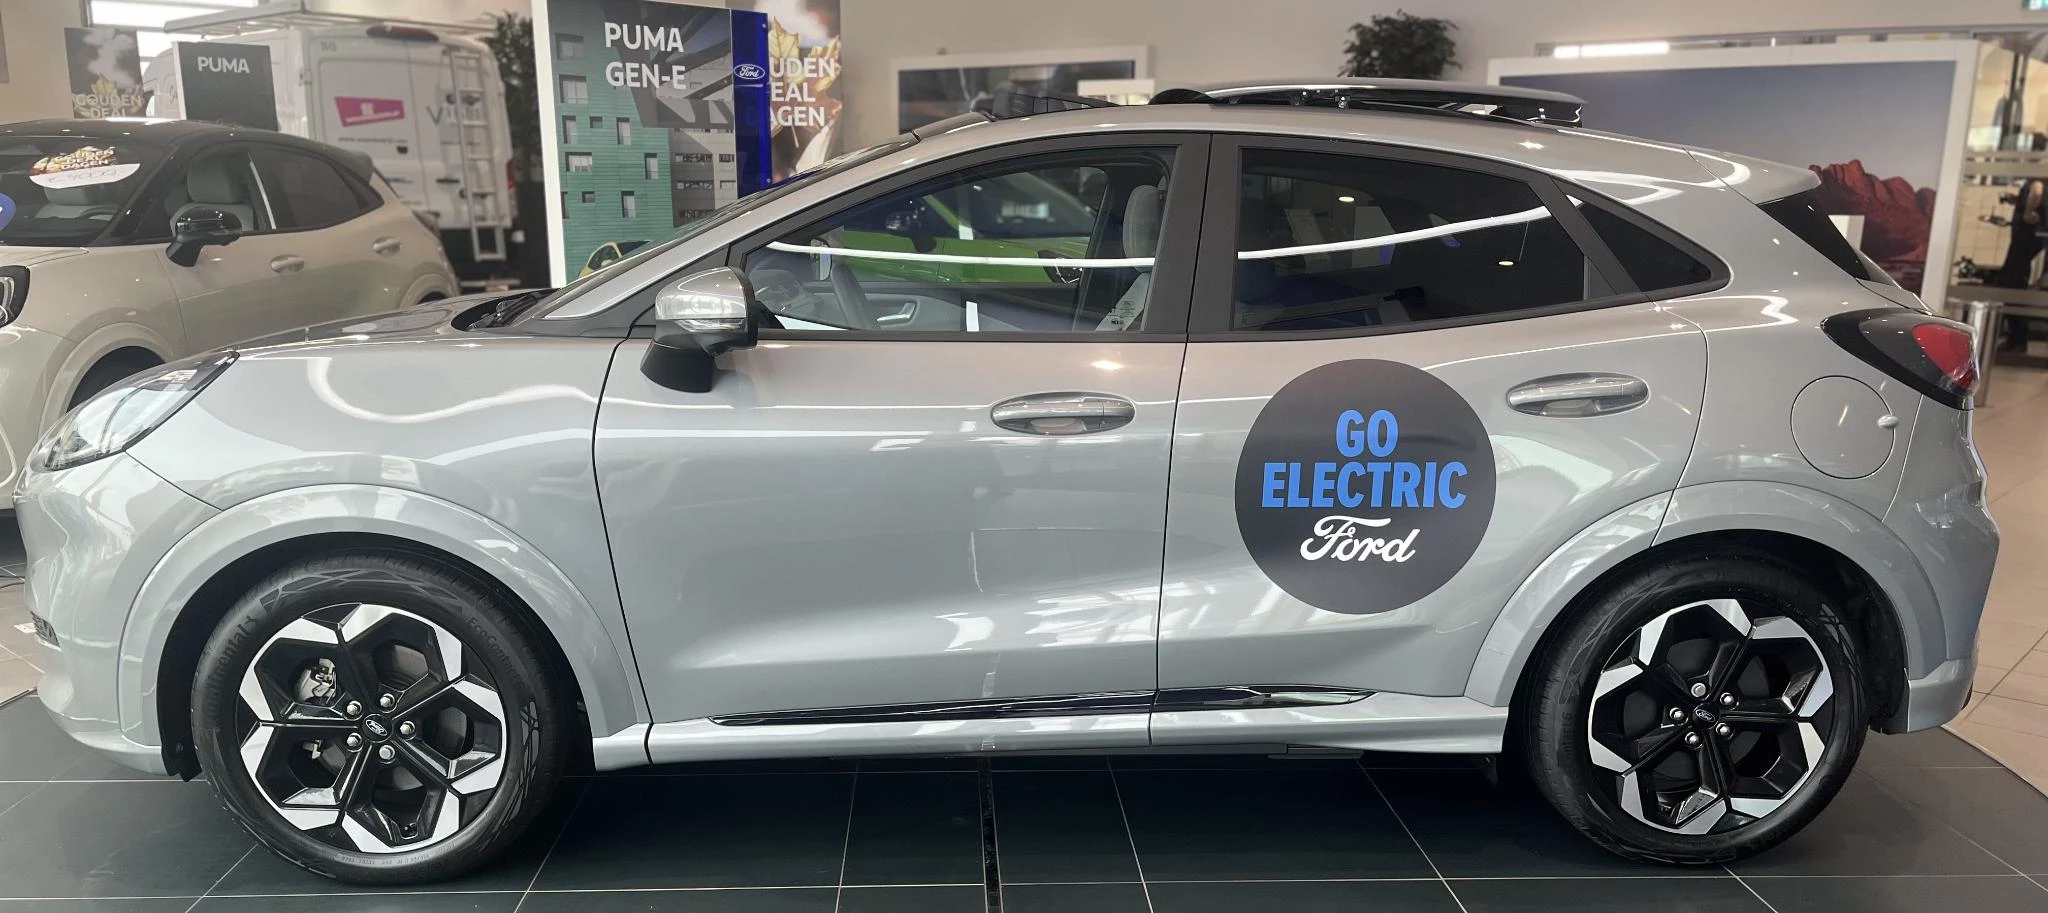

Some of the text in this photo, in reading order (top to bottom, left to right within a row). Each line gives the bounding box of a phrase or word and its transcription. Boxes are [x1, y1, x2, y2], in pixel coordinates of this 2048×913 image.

[604, 22, 684, 52] PUMA
[197, 56, 250, 73] PUMA
[605, 61, 686, 89] GEN-E
[740, 65, 759, 77] Ford
[768, 57, 836, 78] UDEN
[77, 93, 143, 107] GOUDEN
[770, 81, 816, 102] EAL
[89, 108, 127, 118] DEAL
[61, 159, 109, 170] DAGEN
[1336, 409, 1399, 458] GO
[1261, 461, 1468, 509] ELECTRIC
[1300, 514, 1421, 563] Ford
